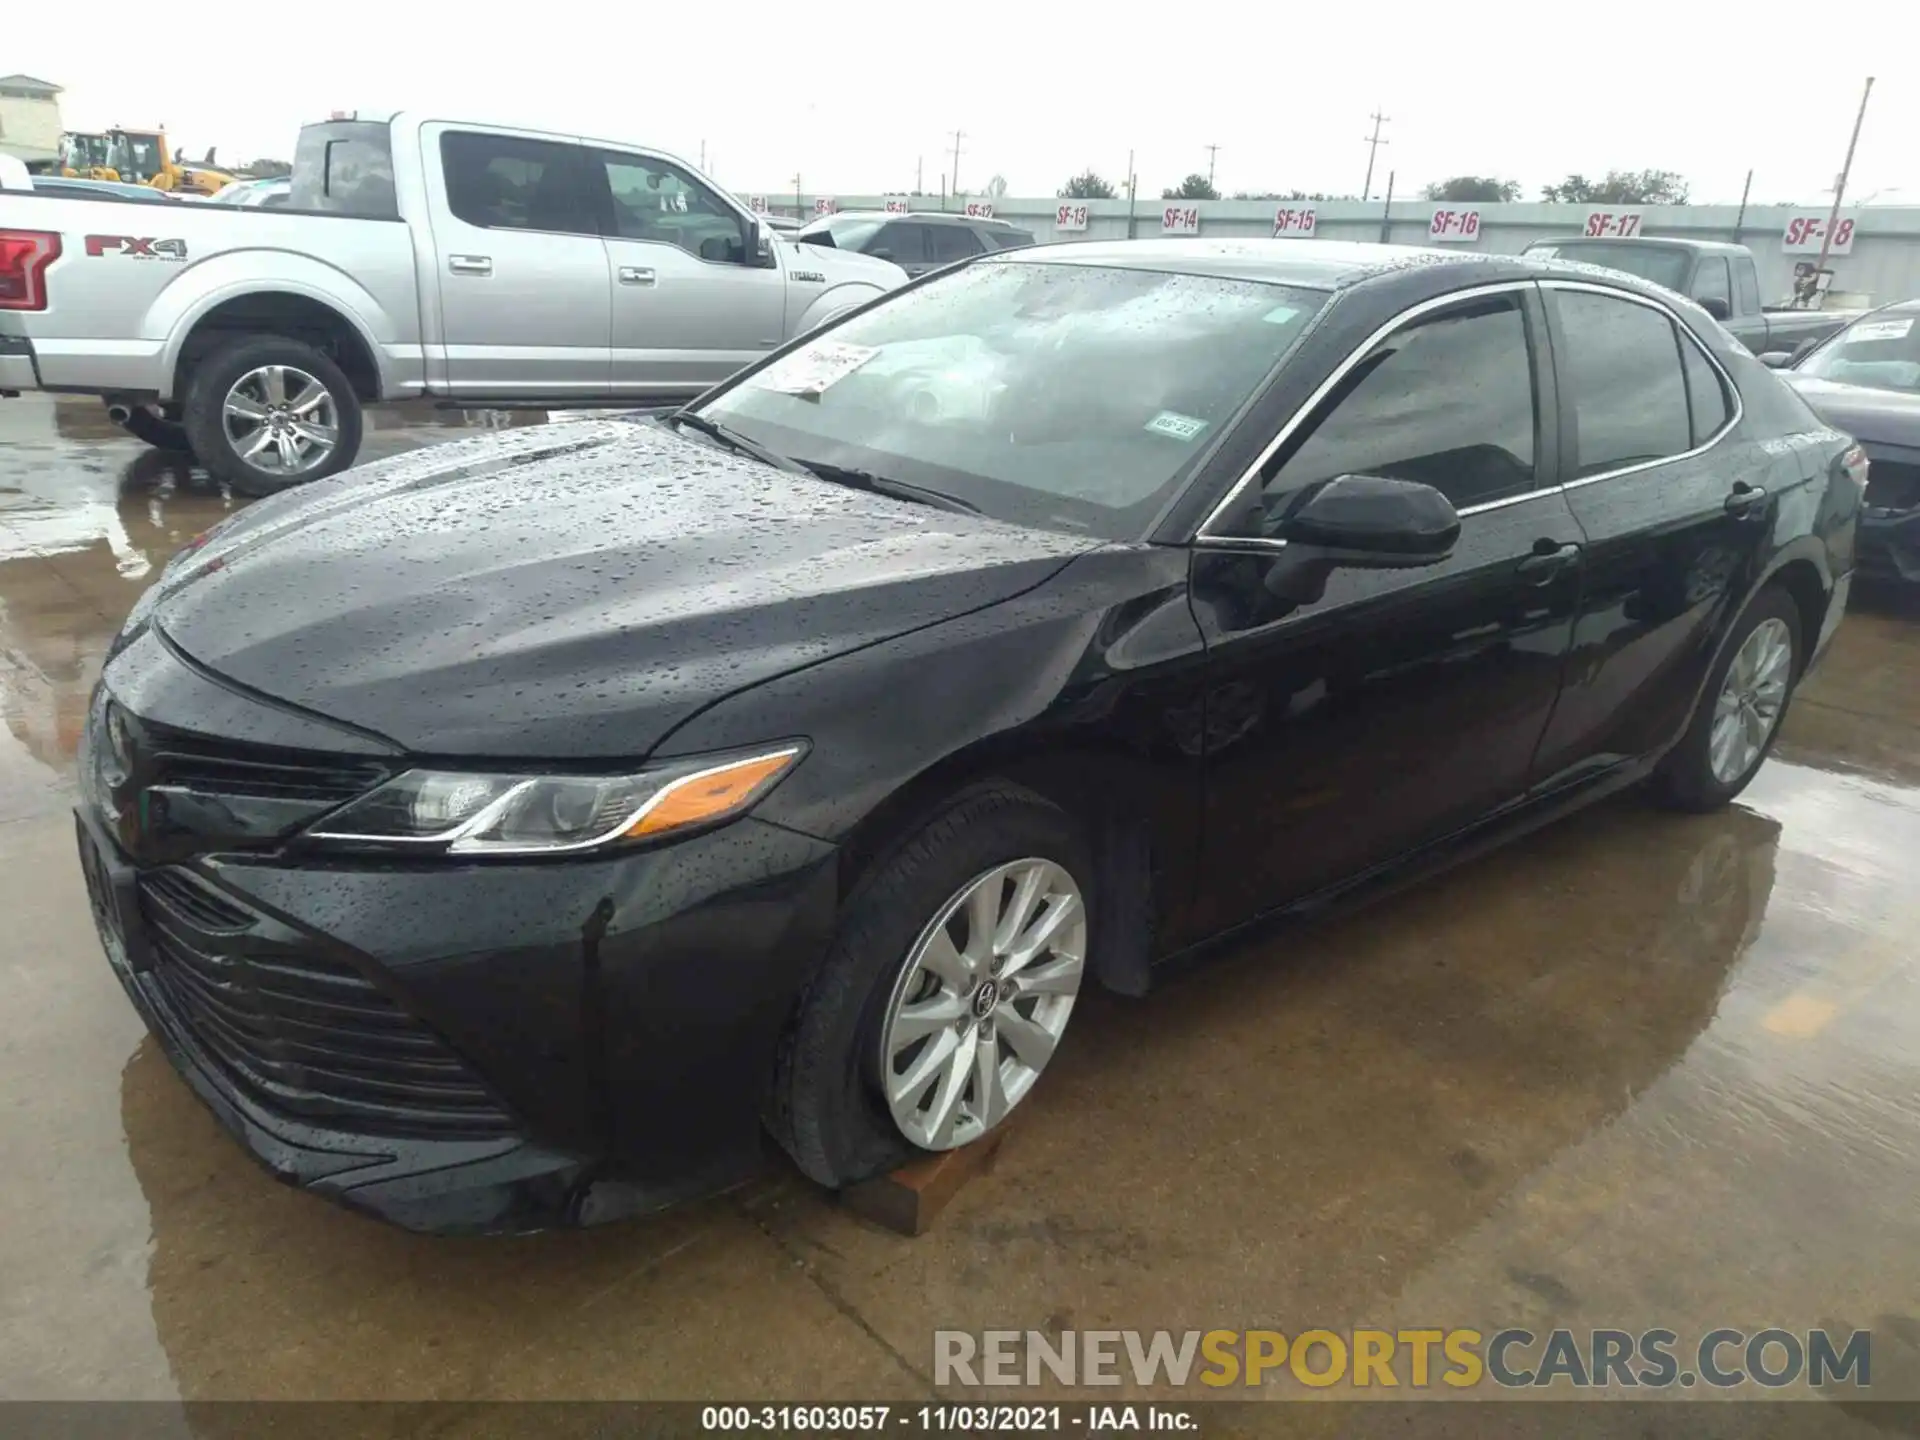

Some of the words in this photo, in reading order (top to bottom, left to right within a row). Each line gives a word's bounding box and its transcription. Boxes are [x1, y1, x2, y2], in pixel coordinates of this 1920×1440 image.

[967, 203, 992, 217] SF-12
[1057, 206, 1086, 226] SF-13
[1164, 207, 1197, 229] SF-14
[1275, 208, 1315, 231] SF-15
[1431, 210, 1479, 234] SF-16
[1586, 212, 1641, 237] SF-17
[1785, 218, 1854, 246] SF-8
[84, 234, 188, 257] FX4
